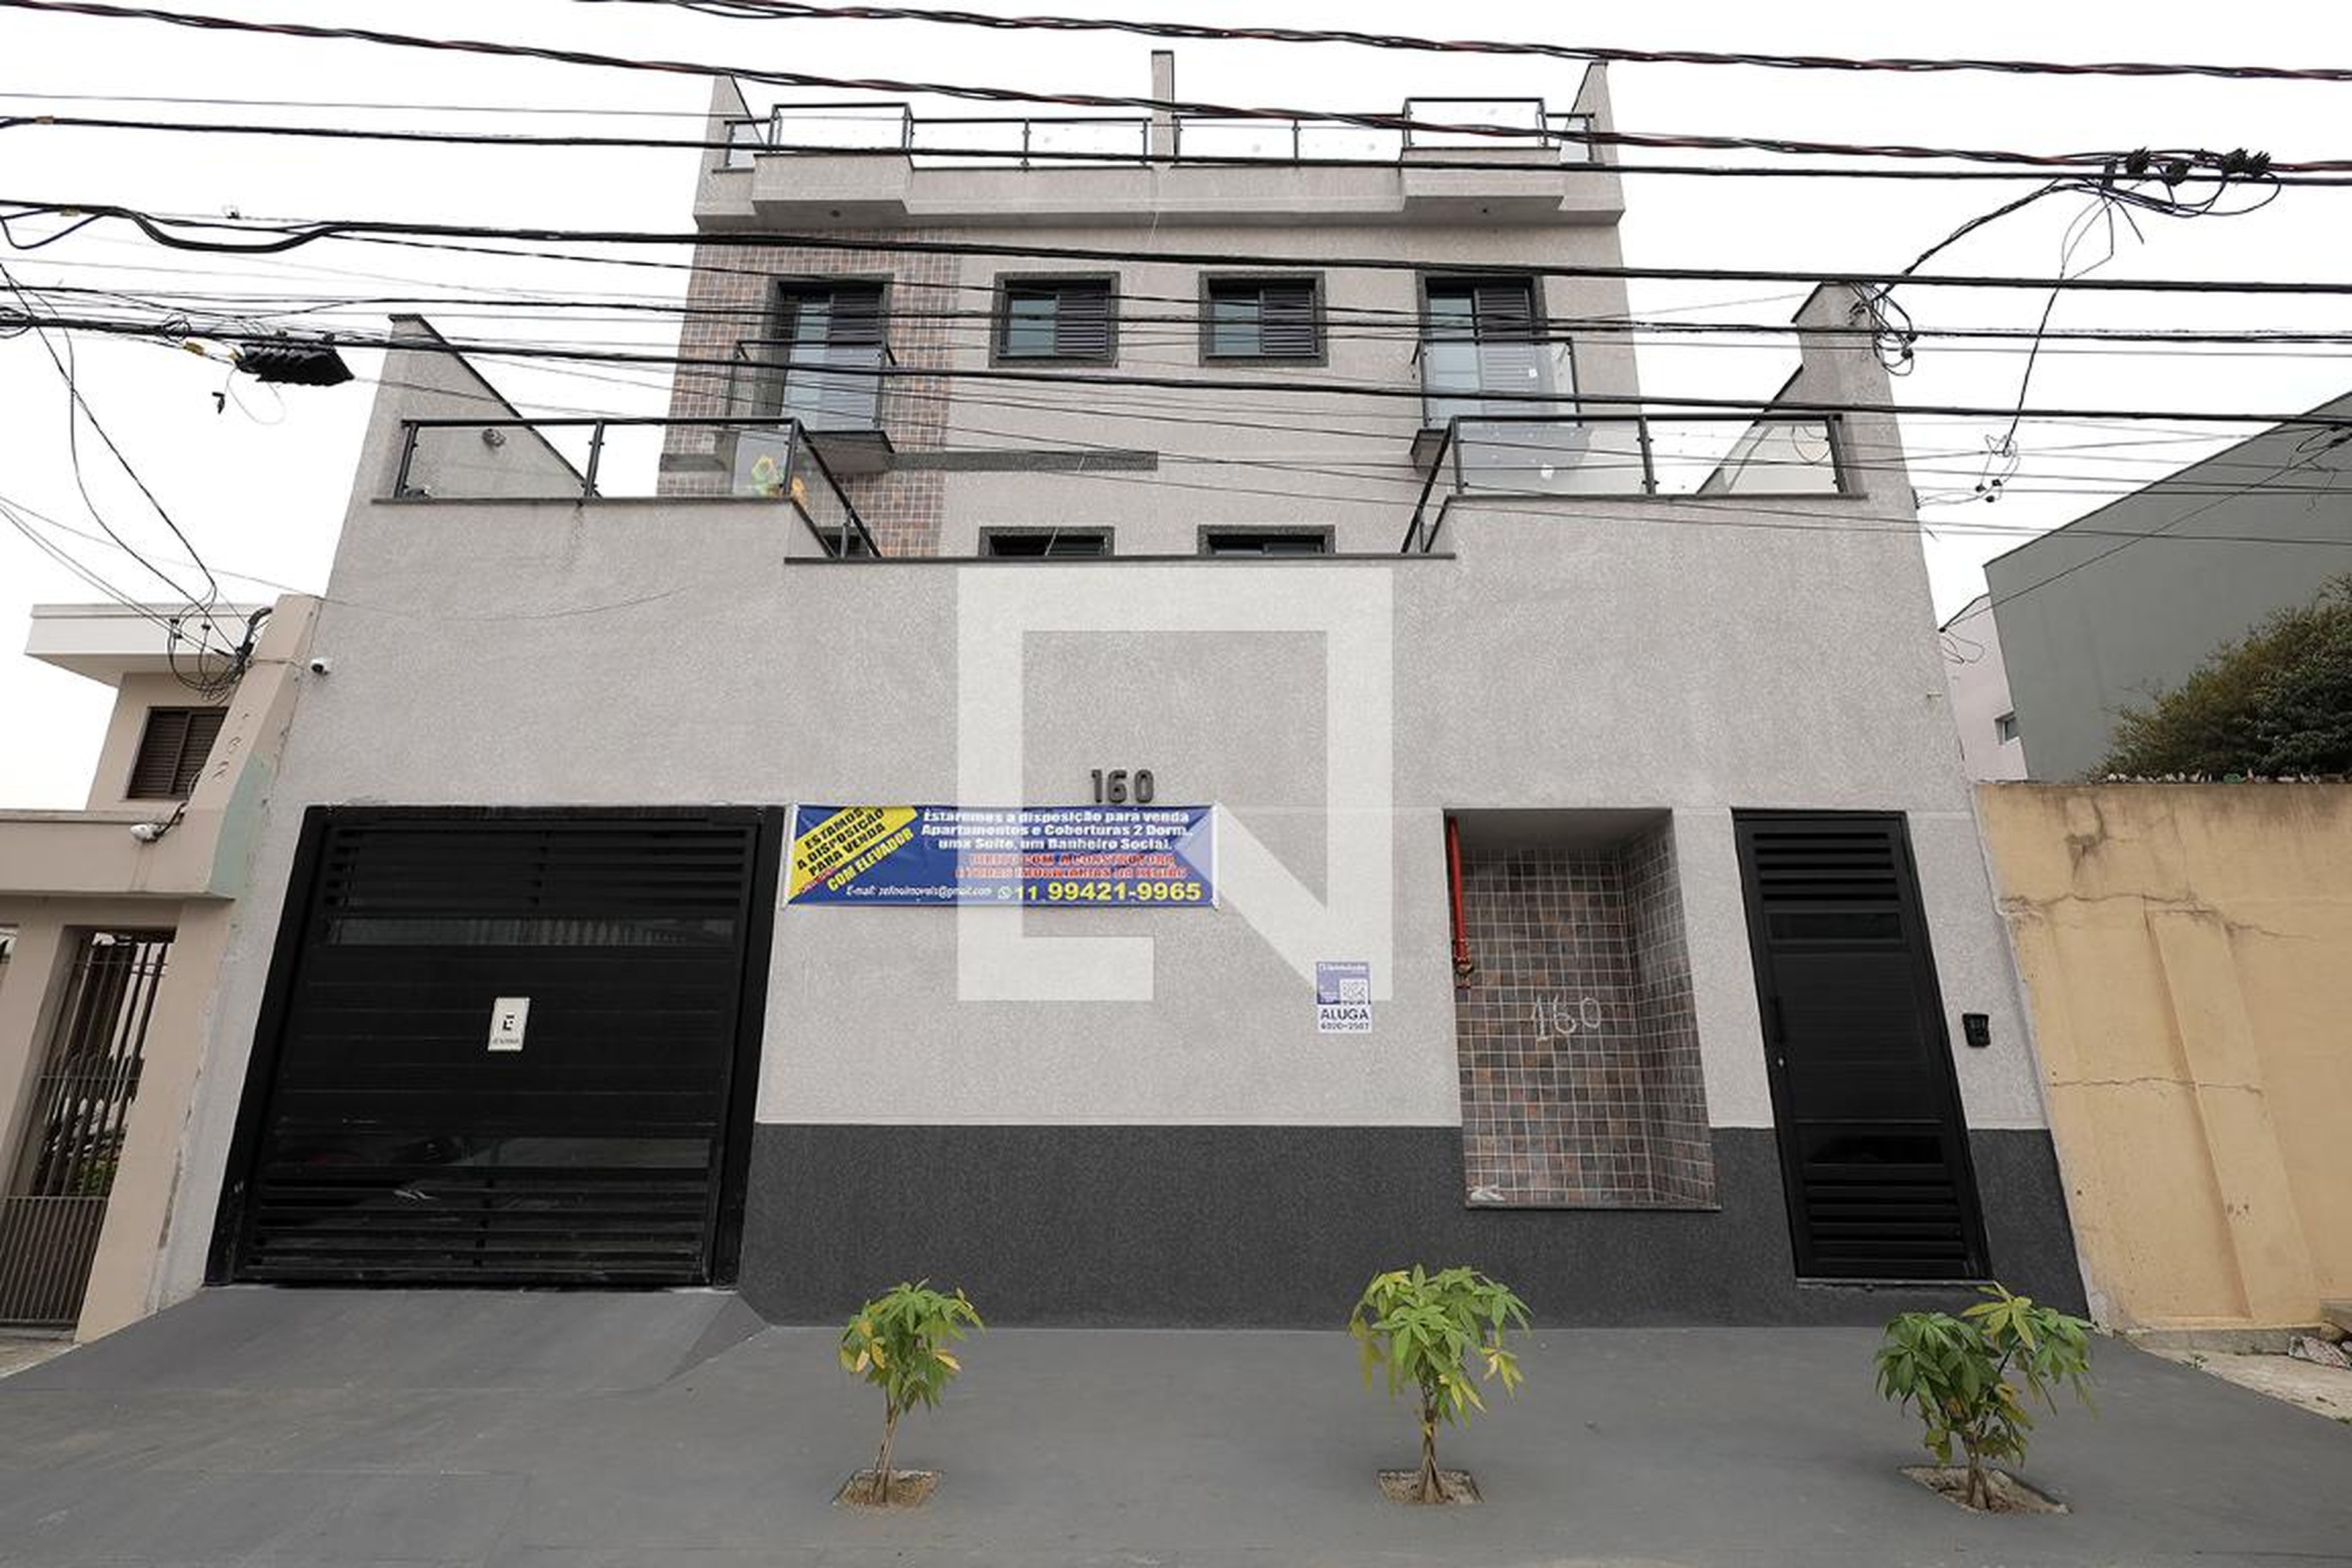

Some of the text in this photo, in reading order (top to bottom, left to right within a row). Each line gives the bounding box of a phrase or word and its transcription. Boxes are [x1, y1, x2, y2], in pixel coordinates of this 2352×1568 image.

[1091, 769, 1153, 804] 160
[1105, 812, 1140, 823] para
[1142, 812, 1189, 822] venda
[1044, 824, 1130, 835] Coberturas
[1133, 824, 1143, 835] 2
[809, 822, 886, 876] PARA VENDA
[1047, 838, 1118, 850] Banheiro
[827, 865, 856, 891] COM
[855, 827, 914, 873] ELEVADOR
[1016, 886, 1038, 900] 11
[1047, 881, 1202, 900] 99421-9965
[1321, 1008, 1369, 1020] ALUGA
[1532, 994, 1601, 1041] 160
